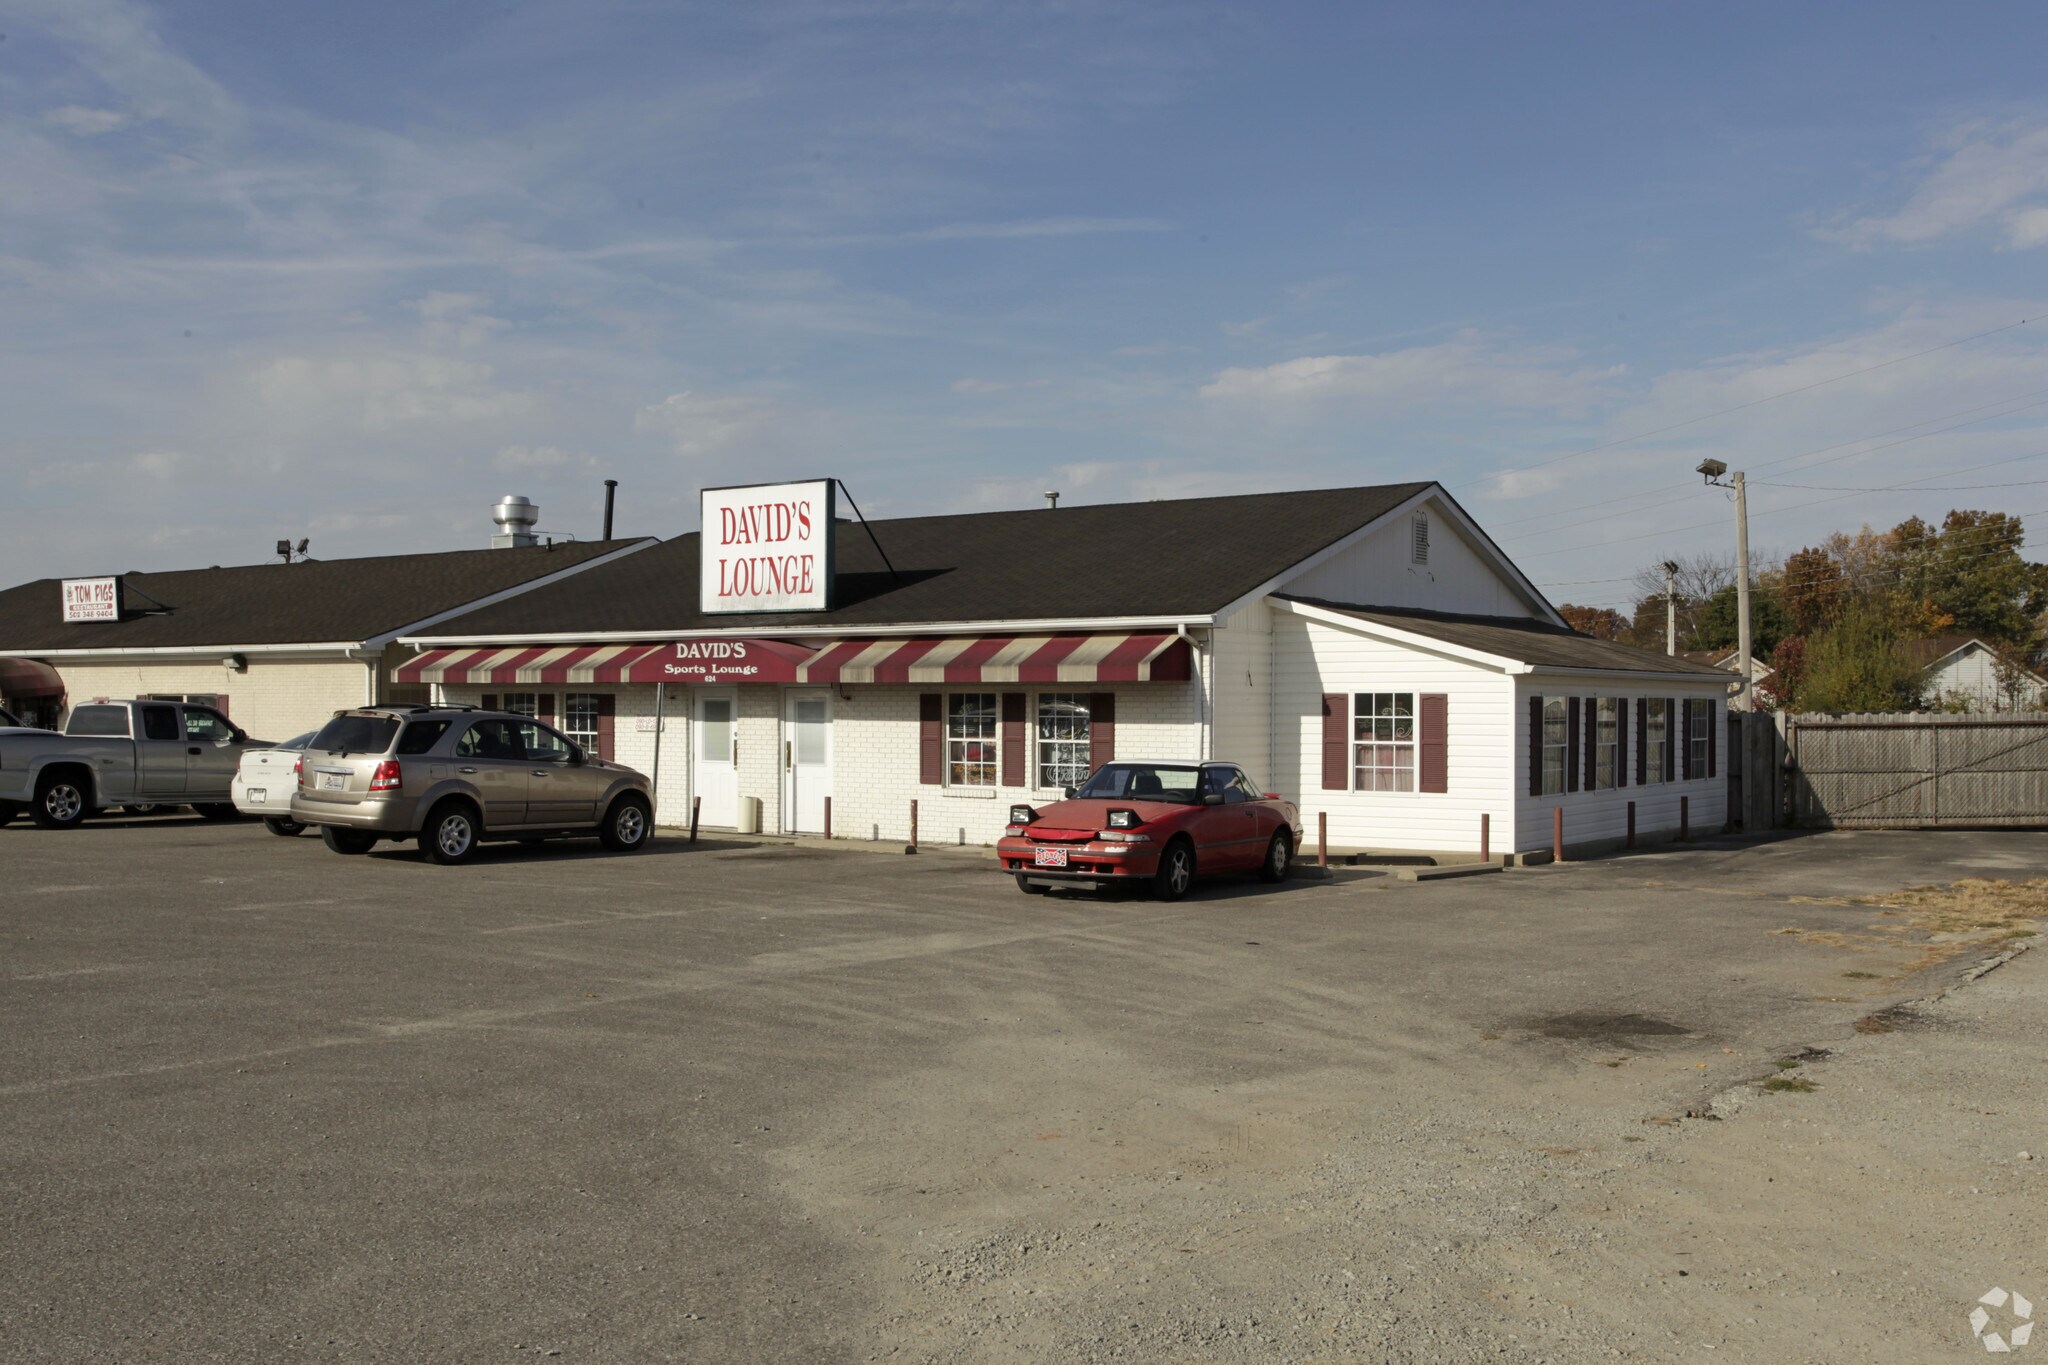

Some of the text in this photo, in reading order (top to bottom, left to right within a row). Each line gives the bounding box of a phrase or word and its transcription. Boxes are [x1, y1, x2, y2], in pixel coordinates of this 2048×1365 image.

[720, 500, 811, 545] DAVID'S
[718, 555, 814, 597] LOUNGE
[74, 583, 113, 603] TOM PIGS
[676, 642, 746, 658] DAVID'S
[664, 664, 758, 675] Sports Lounge
